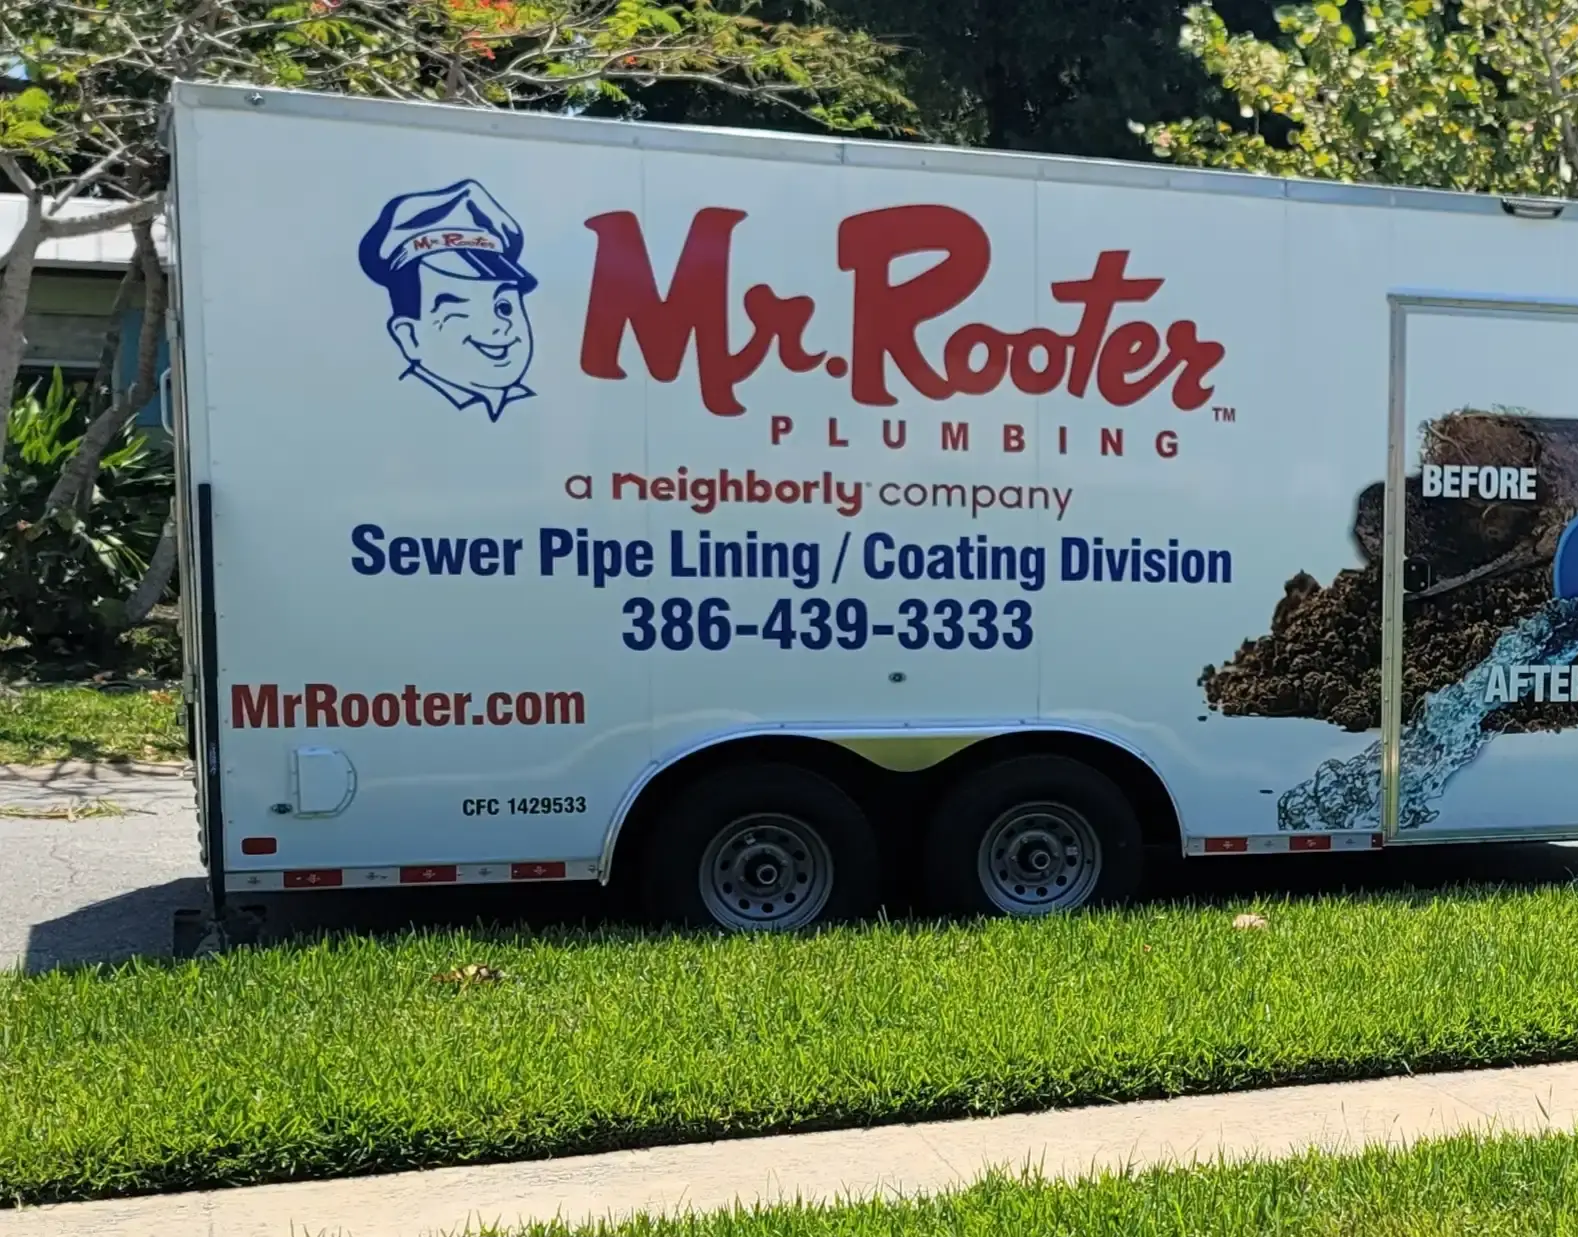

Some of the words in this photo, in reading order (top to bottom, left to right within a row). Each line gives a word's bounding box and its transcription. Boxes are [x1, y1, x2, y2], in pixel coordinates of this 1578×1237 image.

[837, 204, 1225, 411] Rooter
[771, 414, 1180, 459] PLUMBING
[564, 474, 593, 500] a
[612, 466, 863, 517] neighborly
[878, 482, 1073, 521] company
[1422, 464, 1537, 500] BEFORE
[350, 523, 523, 578] Sewer
[538, 527, 654, 588] Pipe
[670, 530, 821, 588] Lining
[831, 531, 851, 584] /
[863, 532, 1046, 591] Coating
[1059, 536, 1233, 584] Division
[621, 597, 1034, 652] 386-439-3333
[230, 683, 586, 730] MrRooter.com
[462, 798, 500, 817] CFC
[507, 795, 587, 816] 1429533
